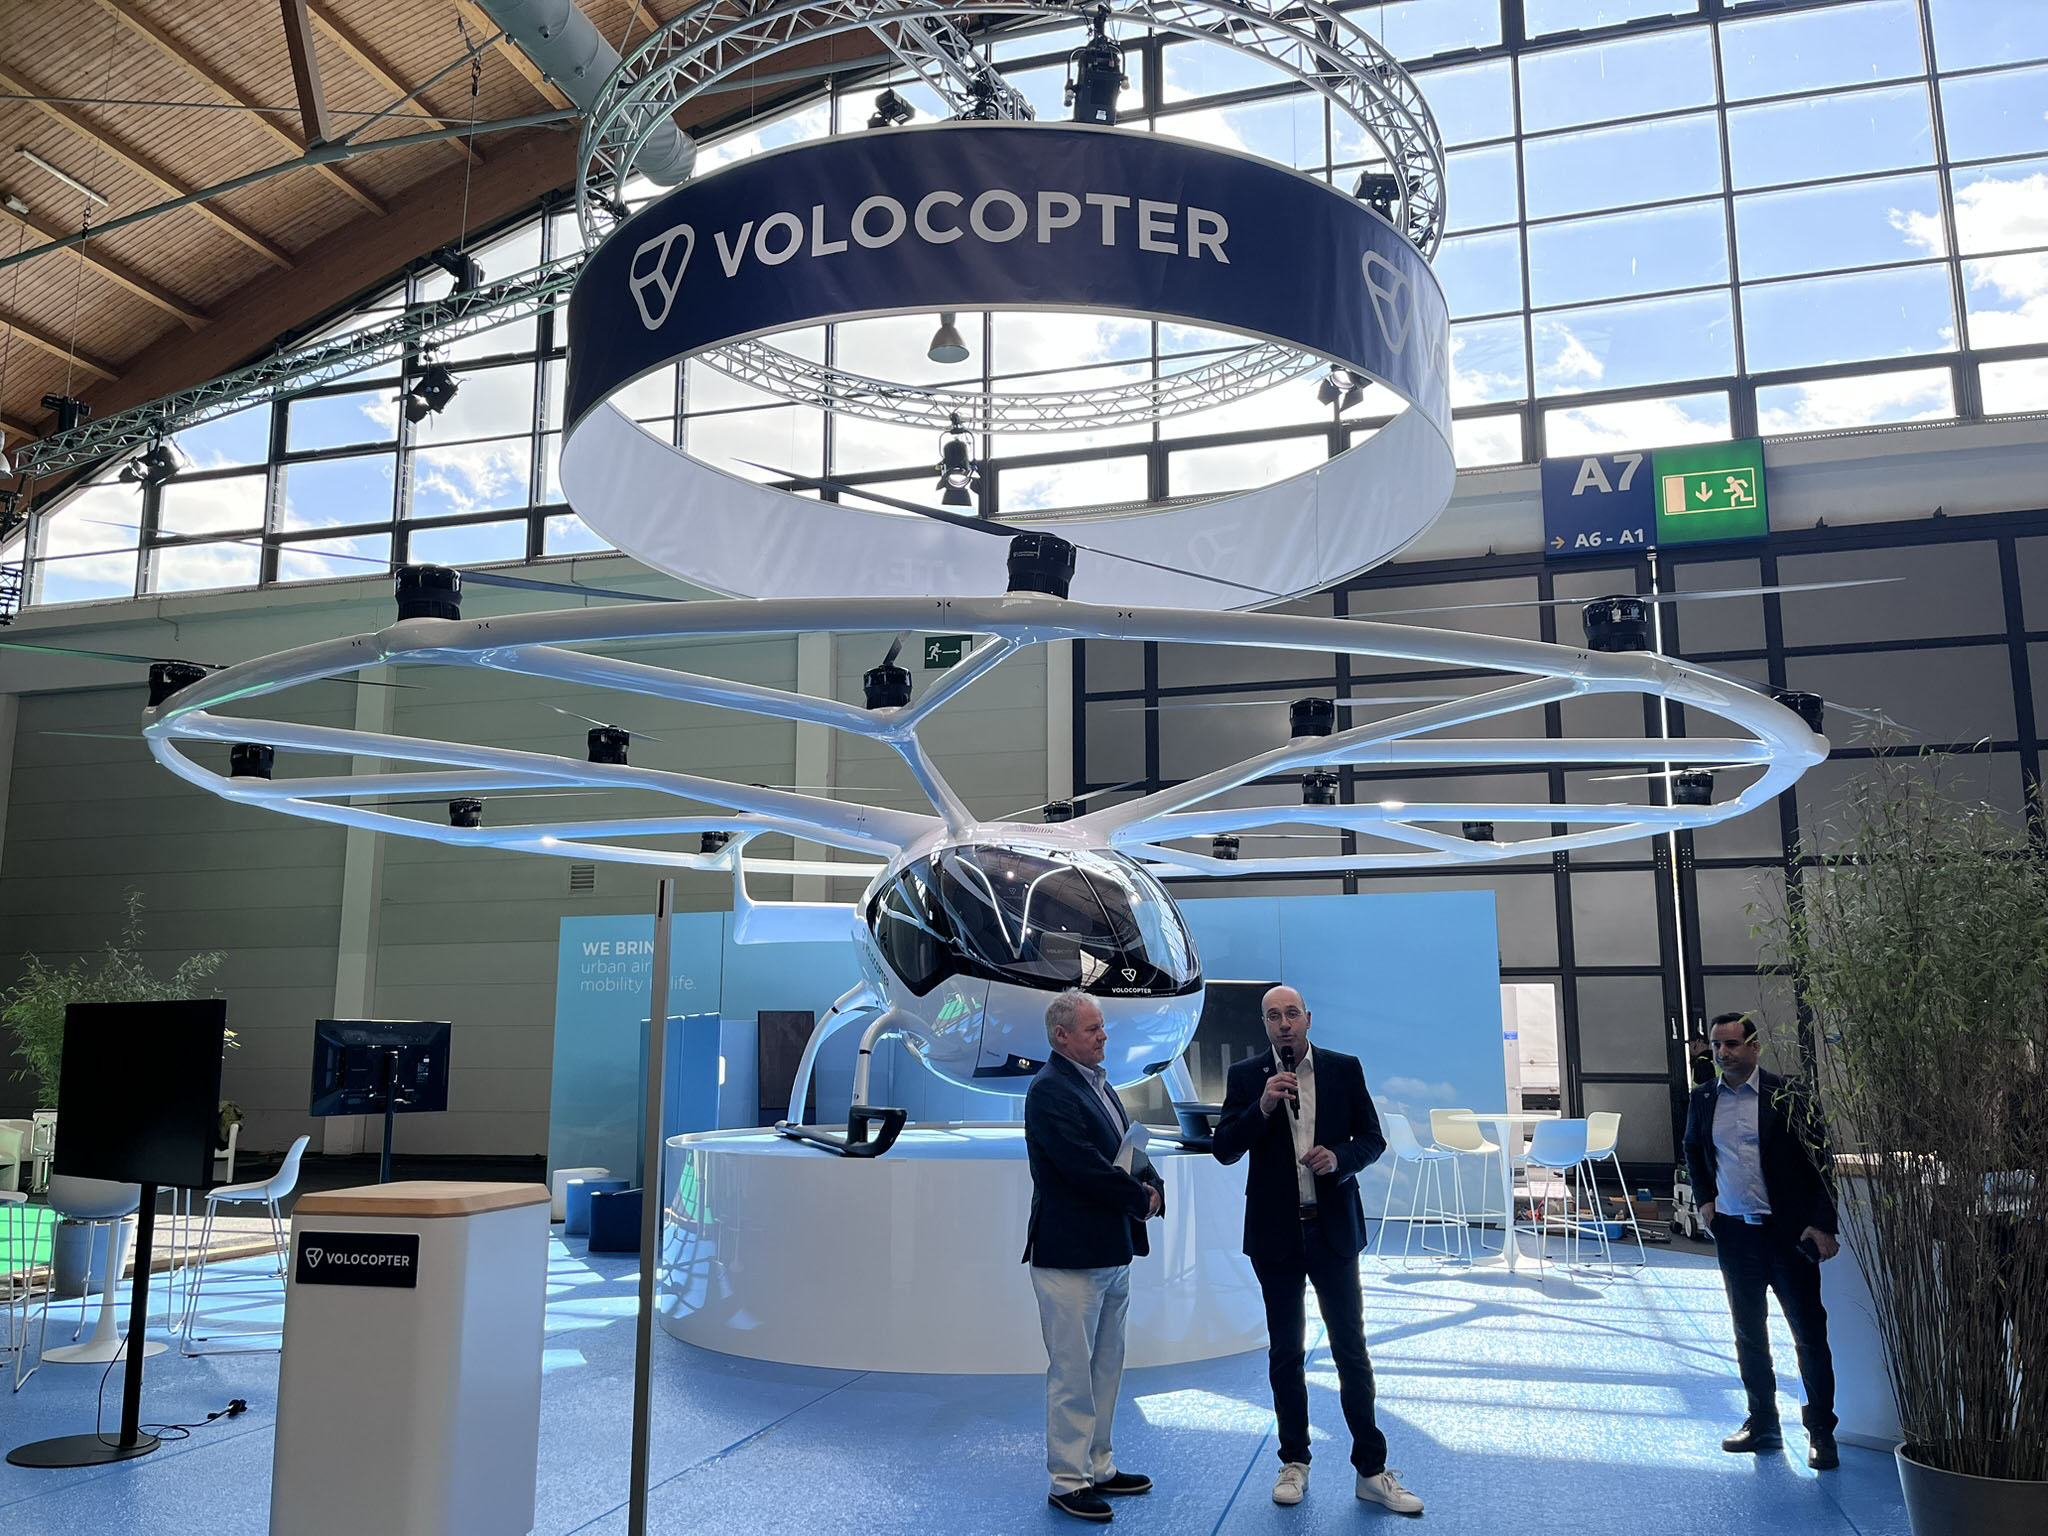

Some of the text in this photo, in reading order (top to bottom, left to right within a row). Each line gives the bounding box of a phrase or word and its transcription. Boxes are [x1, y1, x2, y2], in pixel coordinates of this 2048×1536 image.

[714, 189, 1231, 278] VOLOCOPTER
[1571, 453, 1643, 496] A7
[1574, 532, 1601, 548] A6
[1619, 528, 1644, 544] A1
[582, 941, 654, 956] WE BRIN
[581, 960, 651, 974] urban air
[580, 977, 644, 994] mobility
[670, 974, 697, 991] life.
[326, 1252, 410, 1267] VOLOCOPTER
